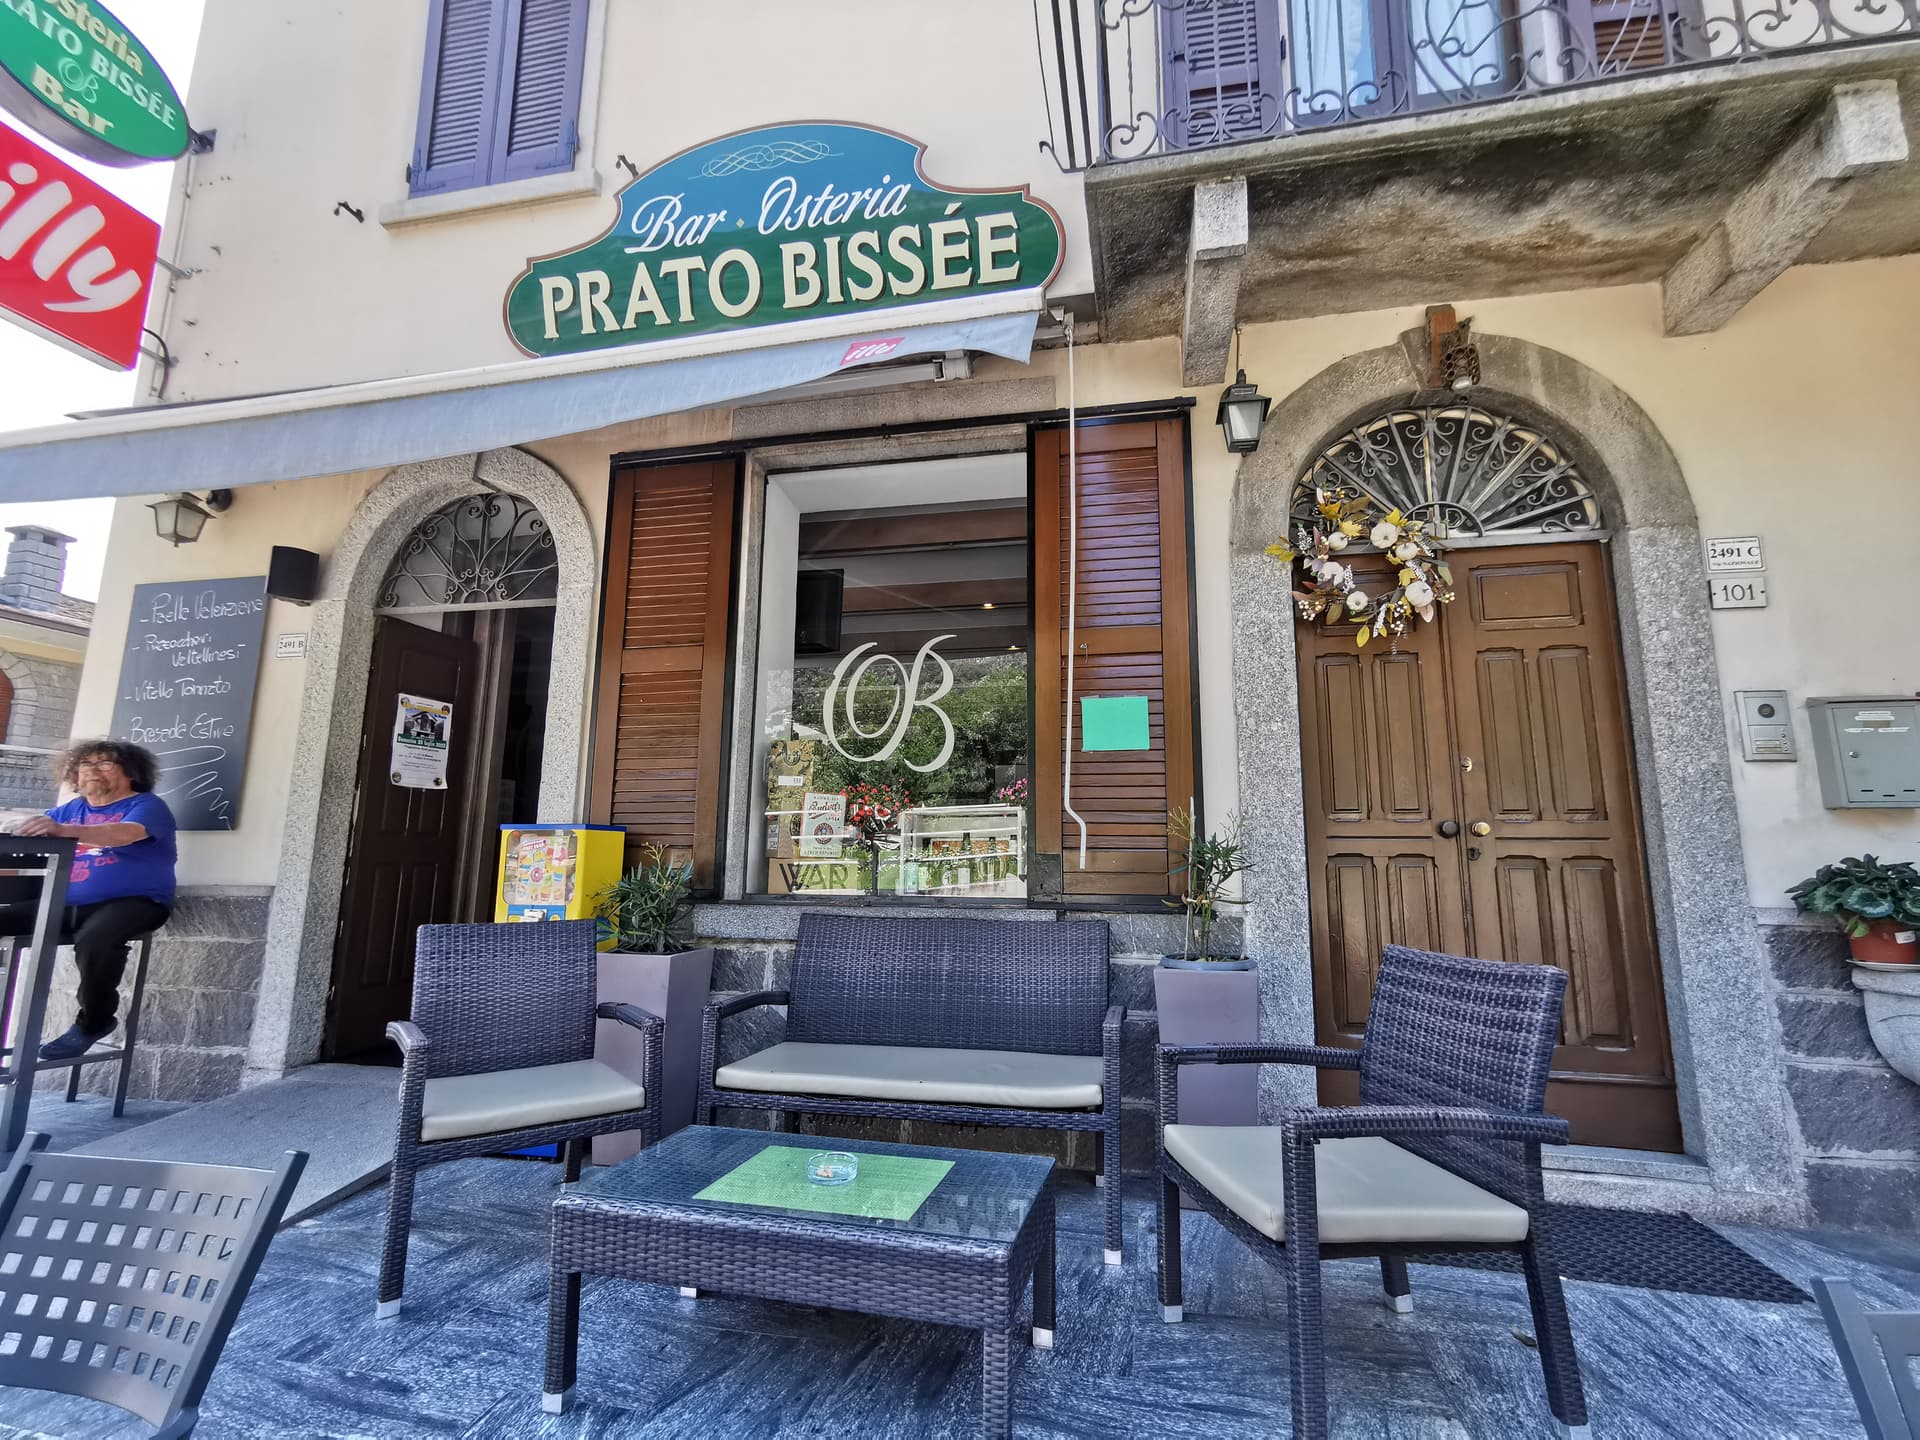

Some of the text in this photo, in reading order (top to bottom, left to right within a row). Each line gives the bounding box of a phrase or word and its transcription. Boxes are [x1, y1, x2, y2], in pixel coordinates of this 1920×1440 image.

[43, 0, 143, 77] steria
[31, 63, 115, 136] Bar
[90, 48, 176, 132] BISSÉE
[624, 175, 911, 254] Bar Osteria
[539, 203, 1021, 341] PRATO BISSÉE
[1709, 546, 1760, 559] 2491 C
[1721, 584, 1756, 602] 101
[135, 680, 174, 702] Vitello
